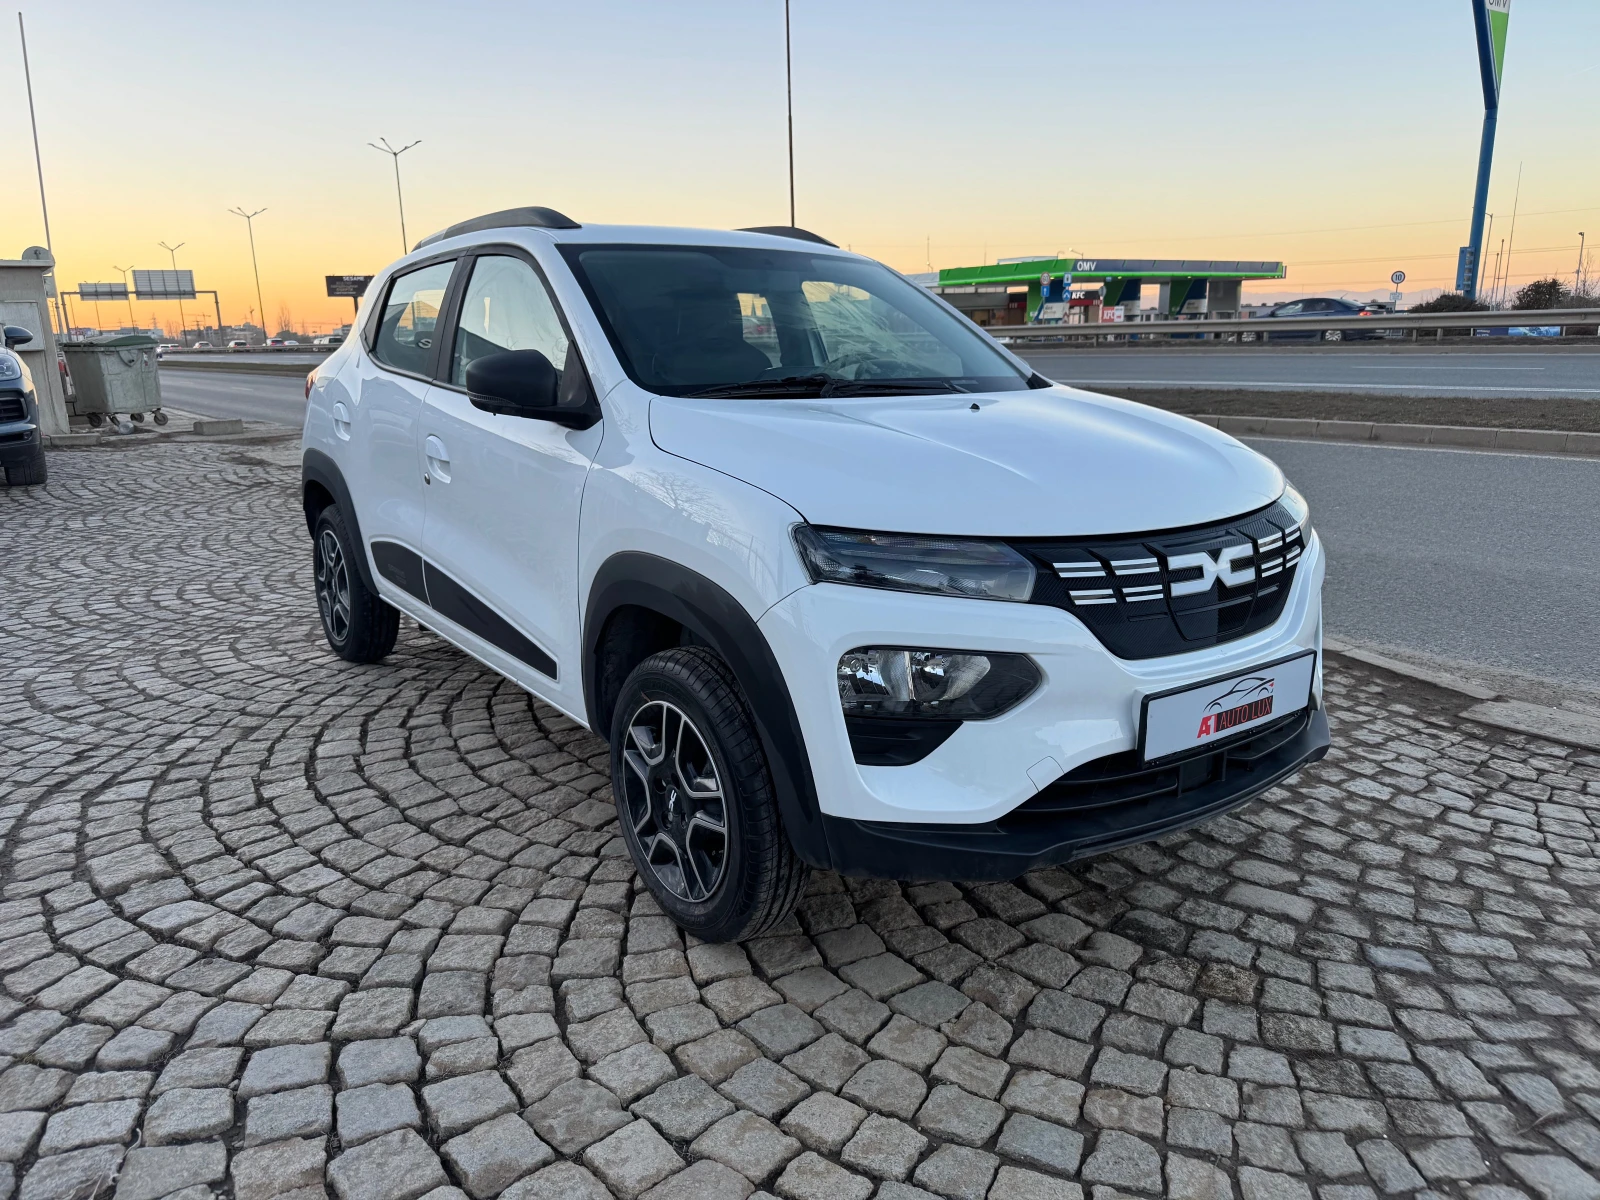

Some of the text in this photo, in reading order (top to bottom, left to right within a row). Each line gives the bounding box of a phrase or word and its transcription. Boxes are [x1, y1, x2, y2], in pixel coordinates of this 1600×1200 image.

[1077, 261, 1096, 271] OMV
[1395, 273, 1403, 281] 10
[1071, 291, 1085, 299] KFC
[1103, 309, 1115, 319] KFC
[1197, 697, 1272, 739] A1 AUTO LUX
